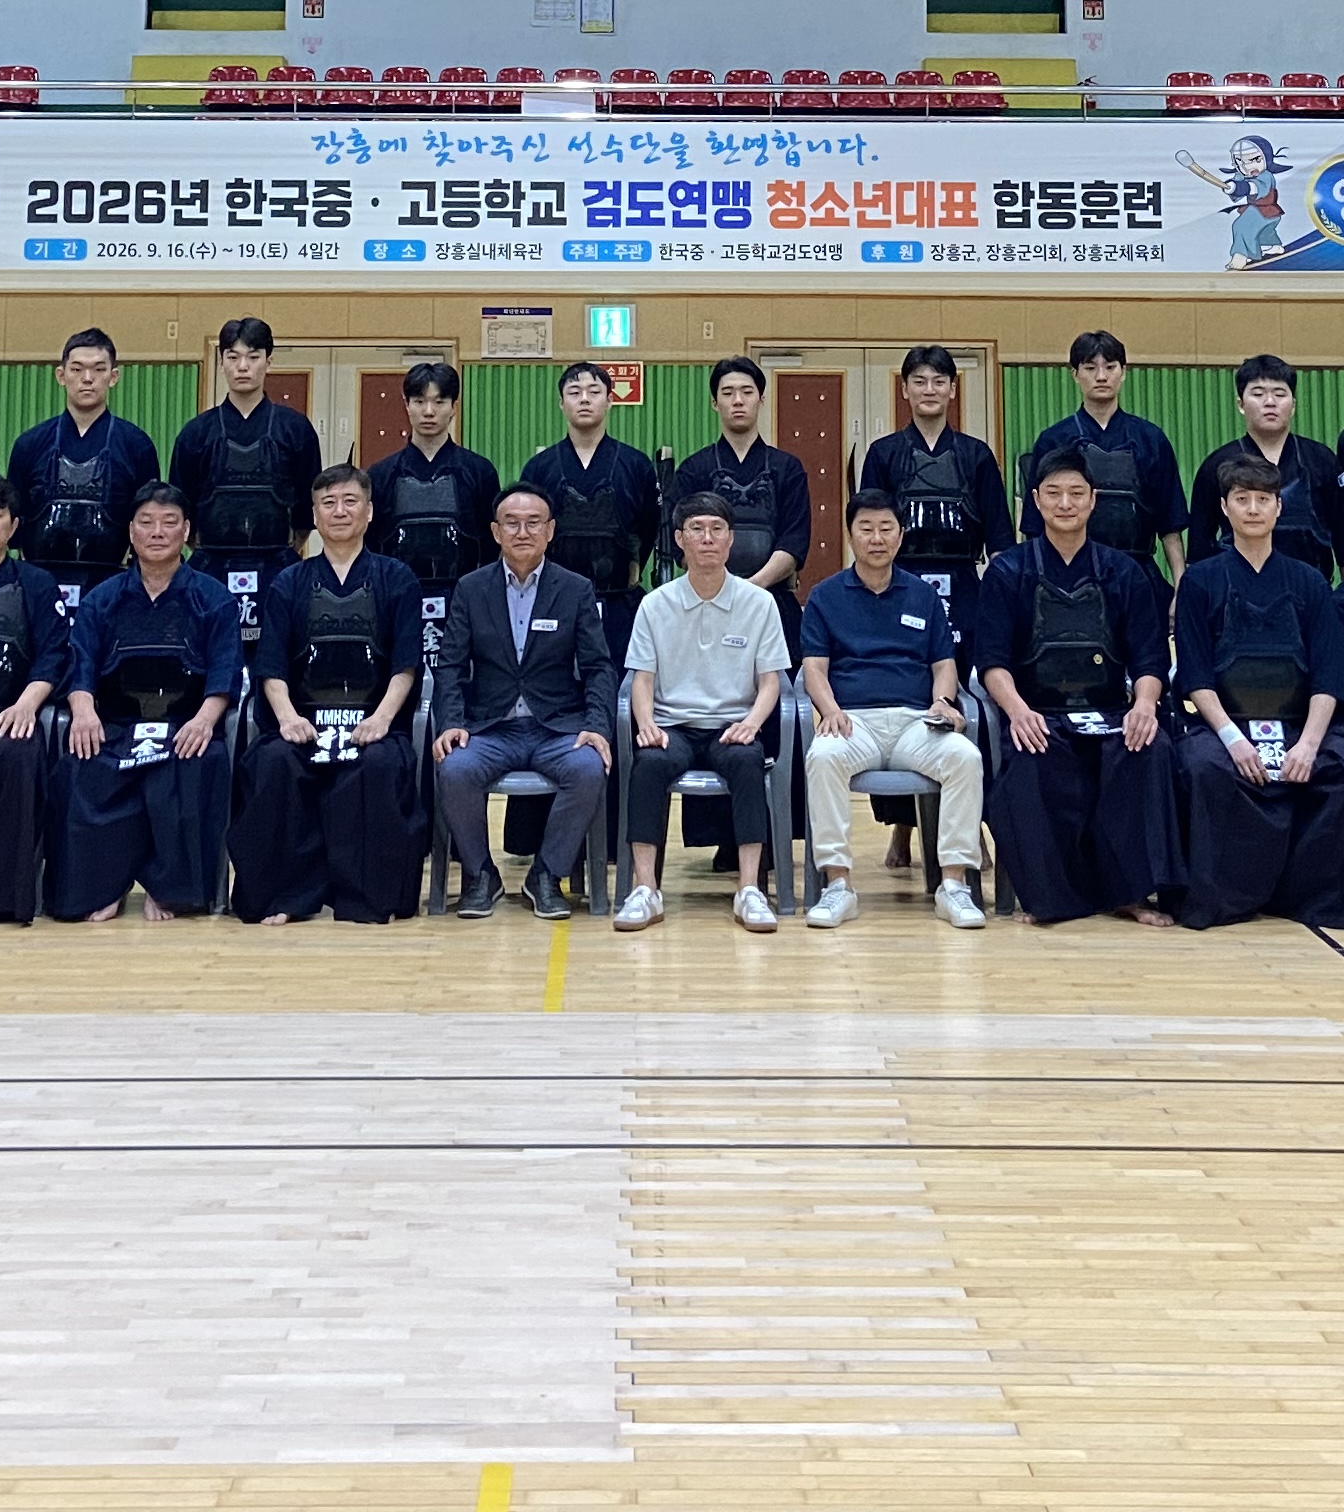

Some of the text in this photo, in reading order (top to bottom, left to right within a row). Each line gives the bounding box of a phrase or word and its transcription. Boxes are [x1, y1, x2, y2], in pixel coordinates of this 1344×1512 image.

[311, 129, 879, 169] 장흥에 찾아주신 선수단을 환영합니다.
[28, 180, 208, 226] 2026년
[226, 179, 352, 226] 한국중
[398, 179, 566, 227] 고등학교
[583, 180, 752, 228] 검도연맹
[766, 179, 978, 229] 청소년대표
[993, 180, 1162, 229] 합동훈련
[97, 243, 142, 259] 2026.
[146, 243, 162, 259] 9.
[297, 243, 341, 261] 4일간
[433, 242, 543, 262] 장흥실내체육관
[658, 244, 705, 261] 한국중
[720, 243, 843, 262] 고등학교검도연맹
[1071, 244, 1165, 263] 장흥군체육회
[317, 710, 364, 725] KMHSKF
